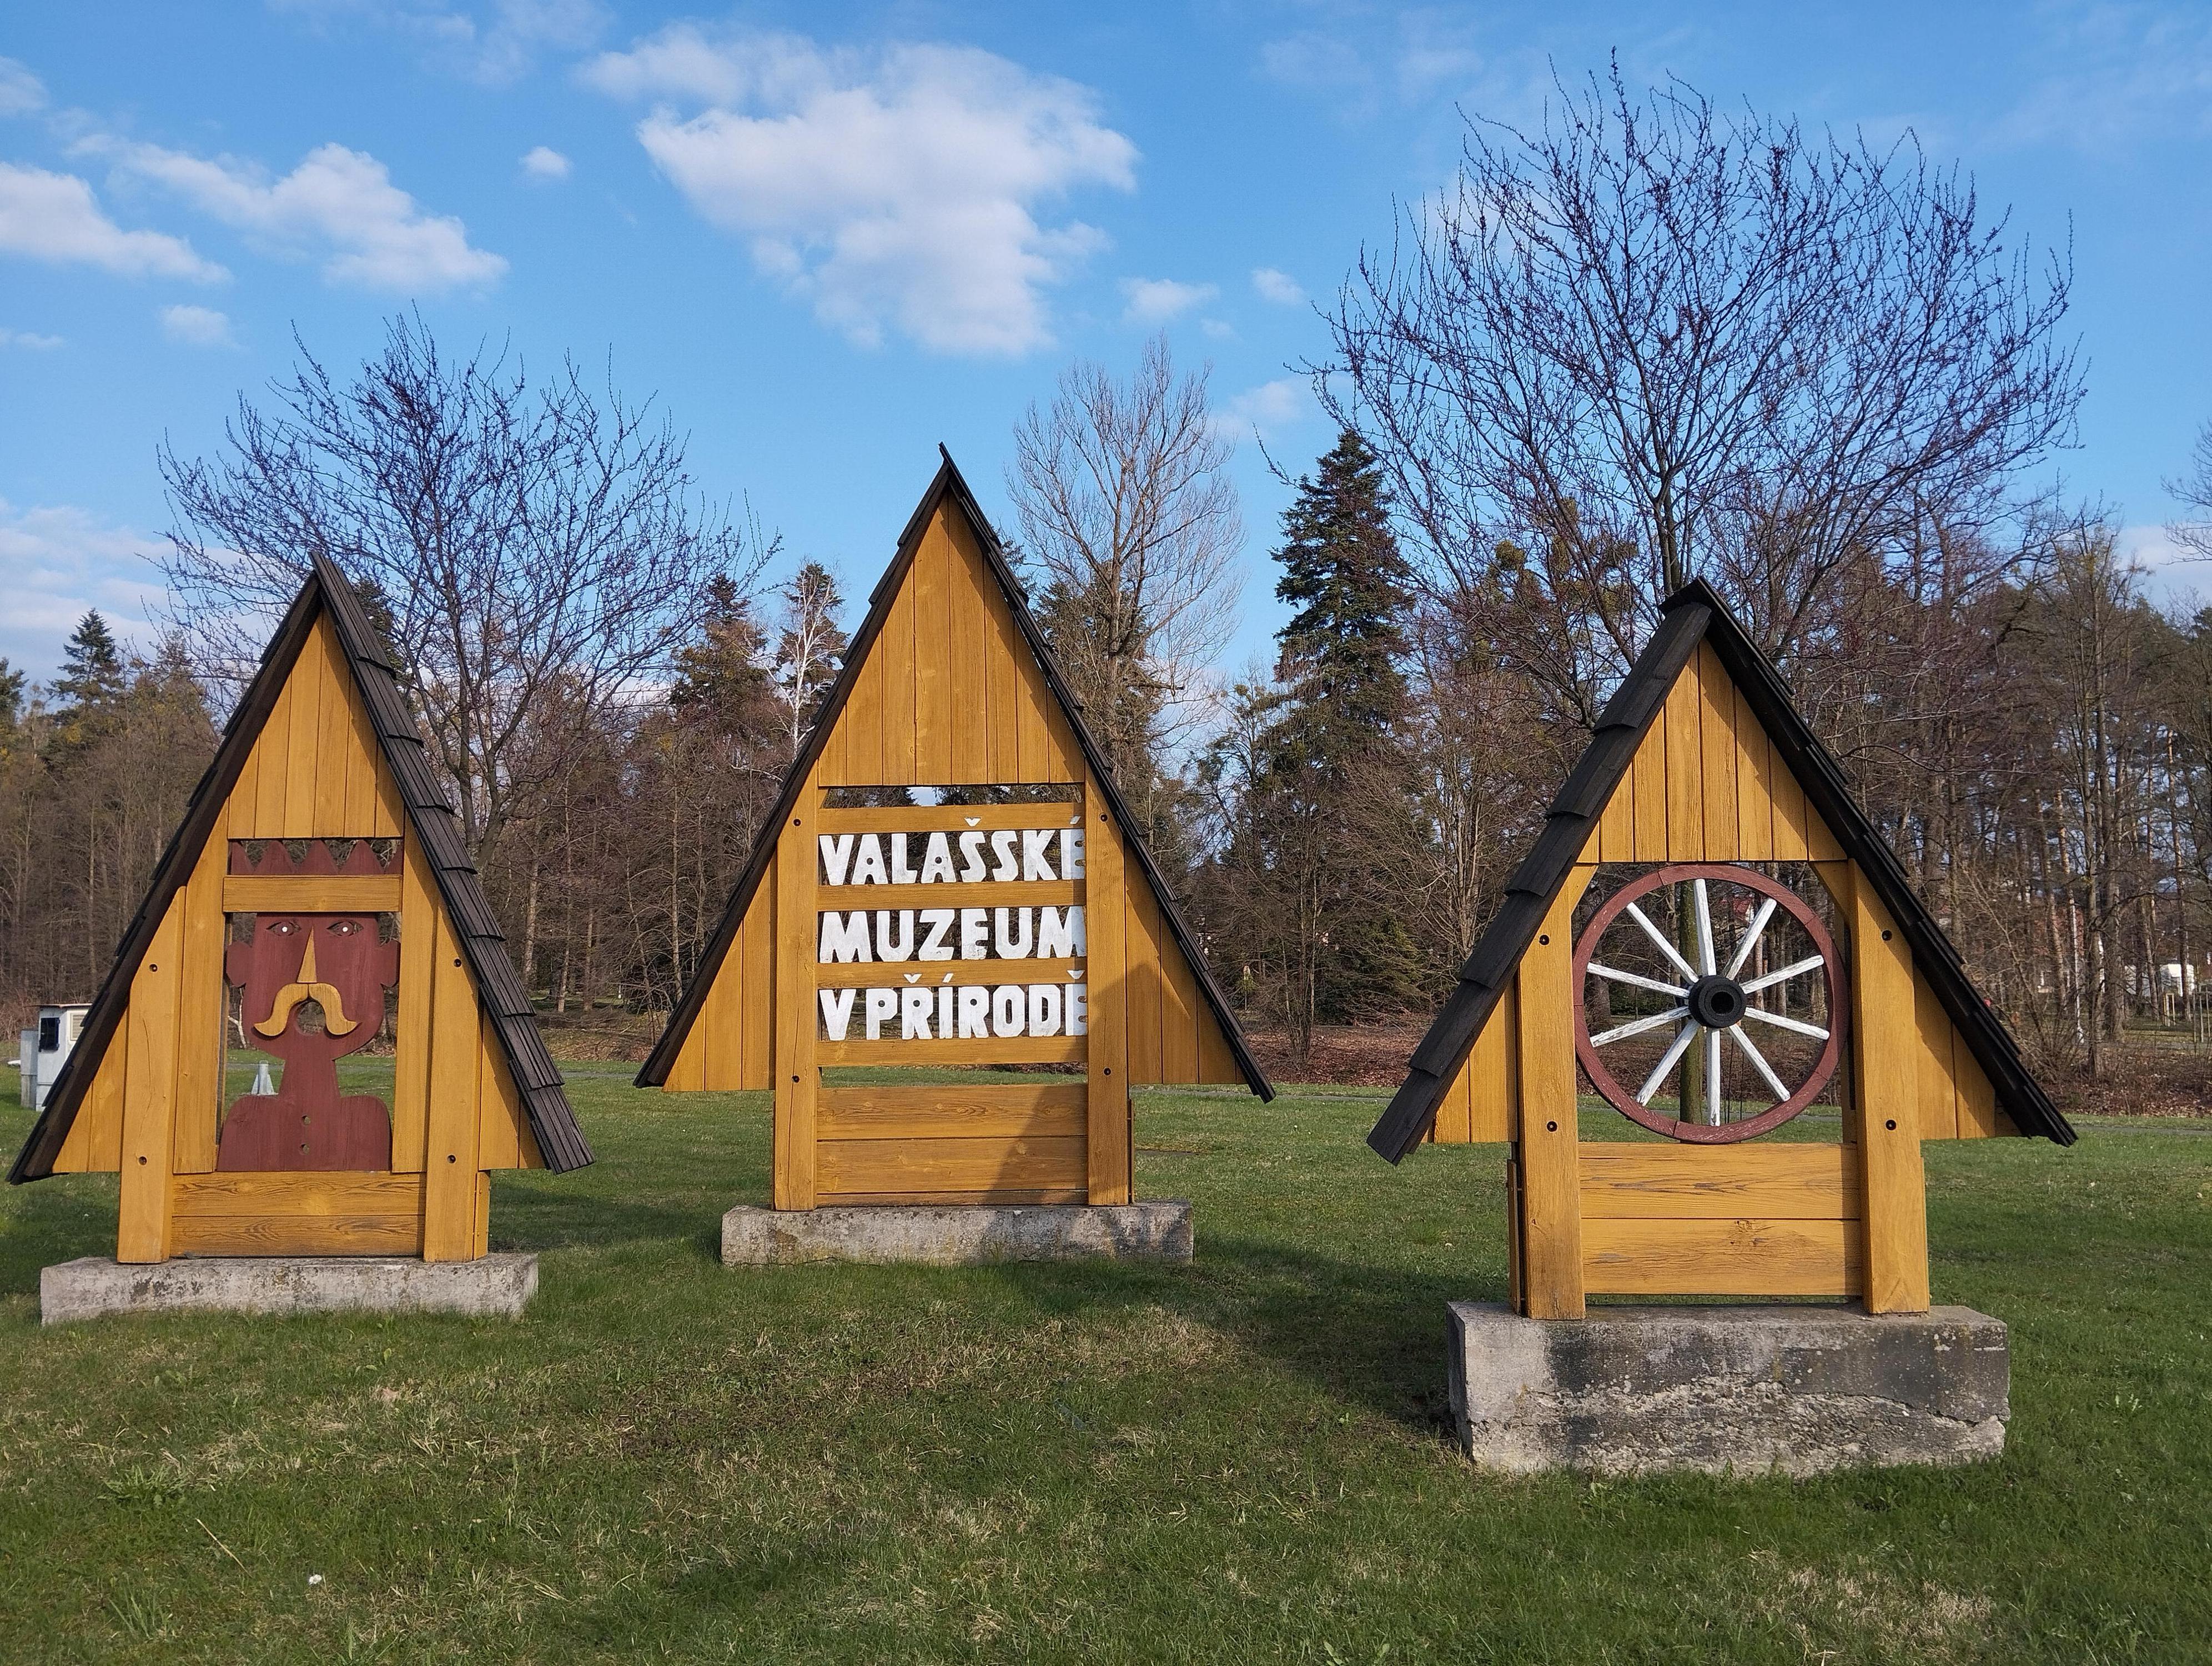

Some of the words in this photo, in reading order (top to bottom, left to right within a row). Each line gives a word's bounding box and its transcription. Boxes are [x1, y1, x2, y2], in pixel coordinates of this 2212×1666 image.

[819, 817, 1085, 885] VALAŠSKÉ
[820, 906, 1087, 963] MUZEUM
[819, 988, 856, 1040] V
[866, 970, 1087, 1040] PŘÍRODĚ
